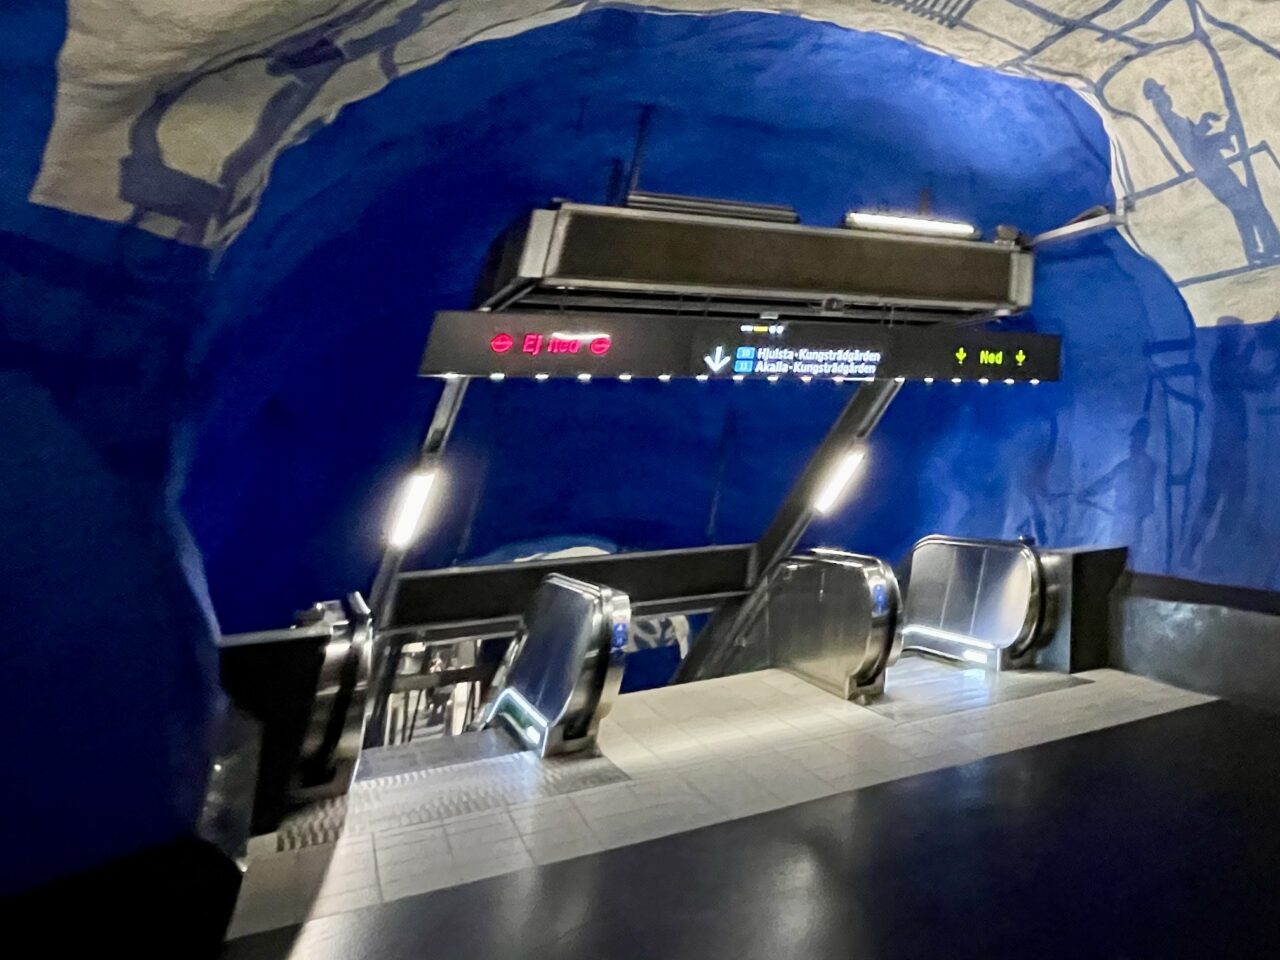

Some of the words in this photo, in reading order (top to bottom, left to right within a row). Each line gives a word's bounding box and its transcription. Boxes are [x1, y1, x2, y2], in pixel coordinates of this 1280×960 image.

[522, 334, 543, 356] Ej
[757, 347, 794, 361] Hjulsta
[799, 348, 881, 363] Kungsträdgården
[980, 350, 1003, 364] Ned
[754, 360, 789, 373] Akalla
[793, 361, 876, 375] Kungsträdgården
